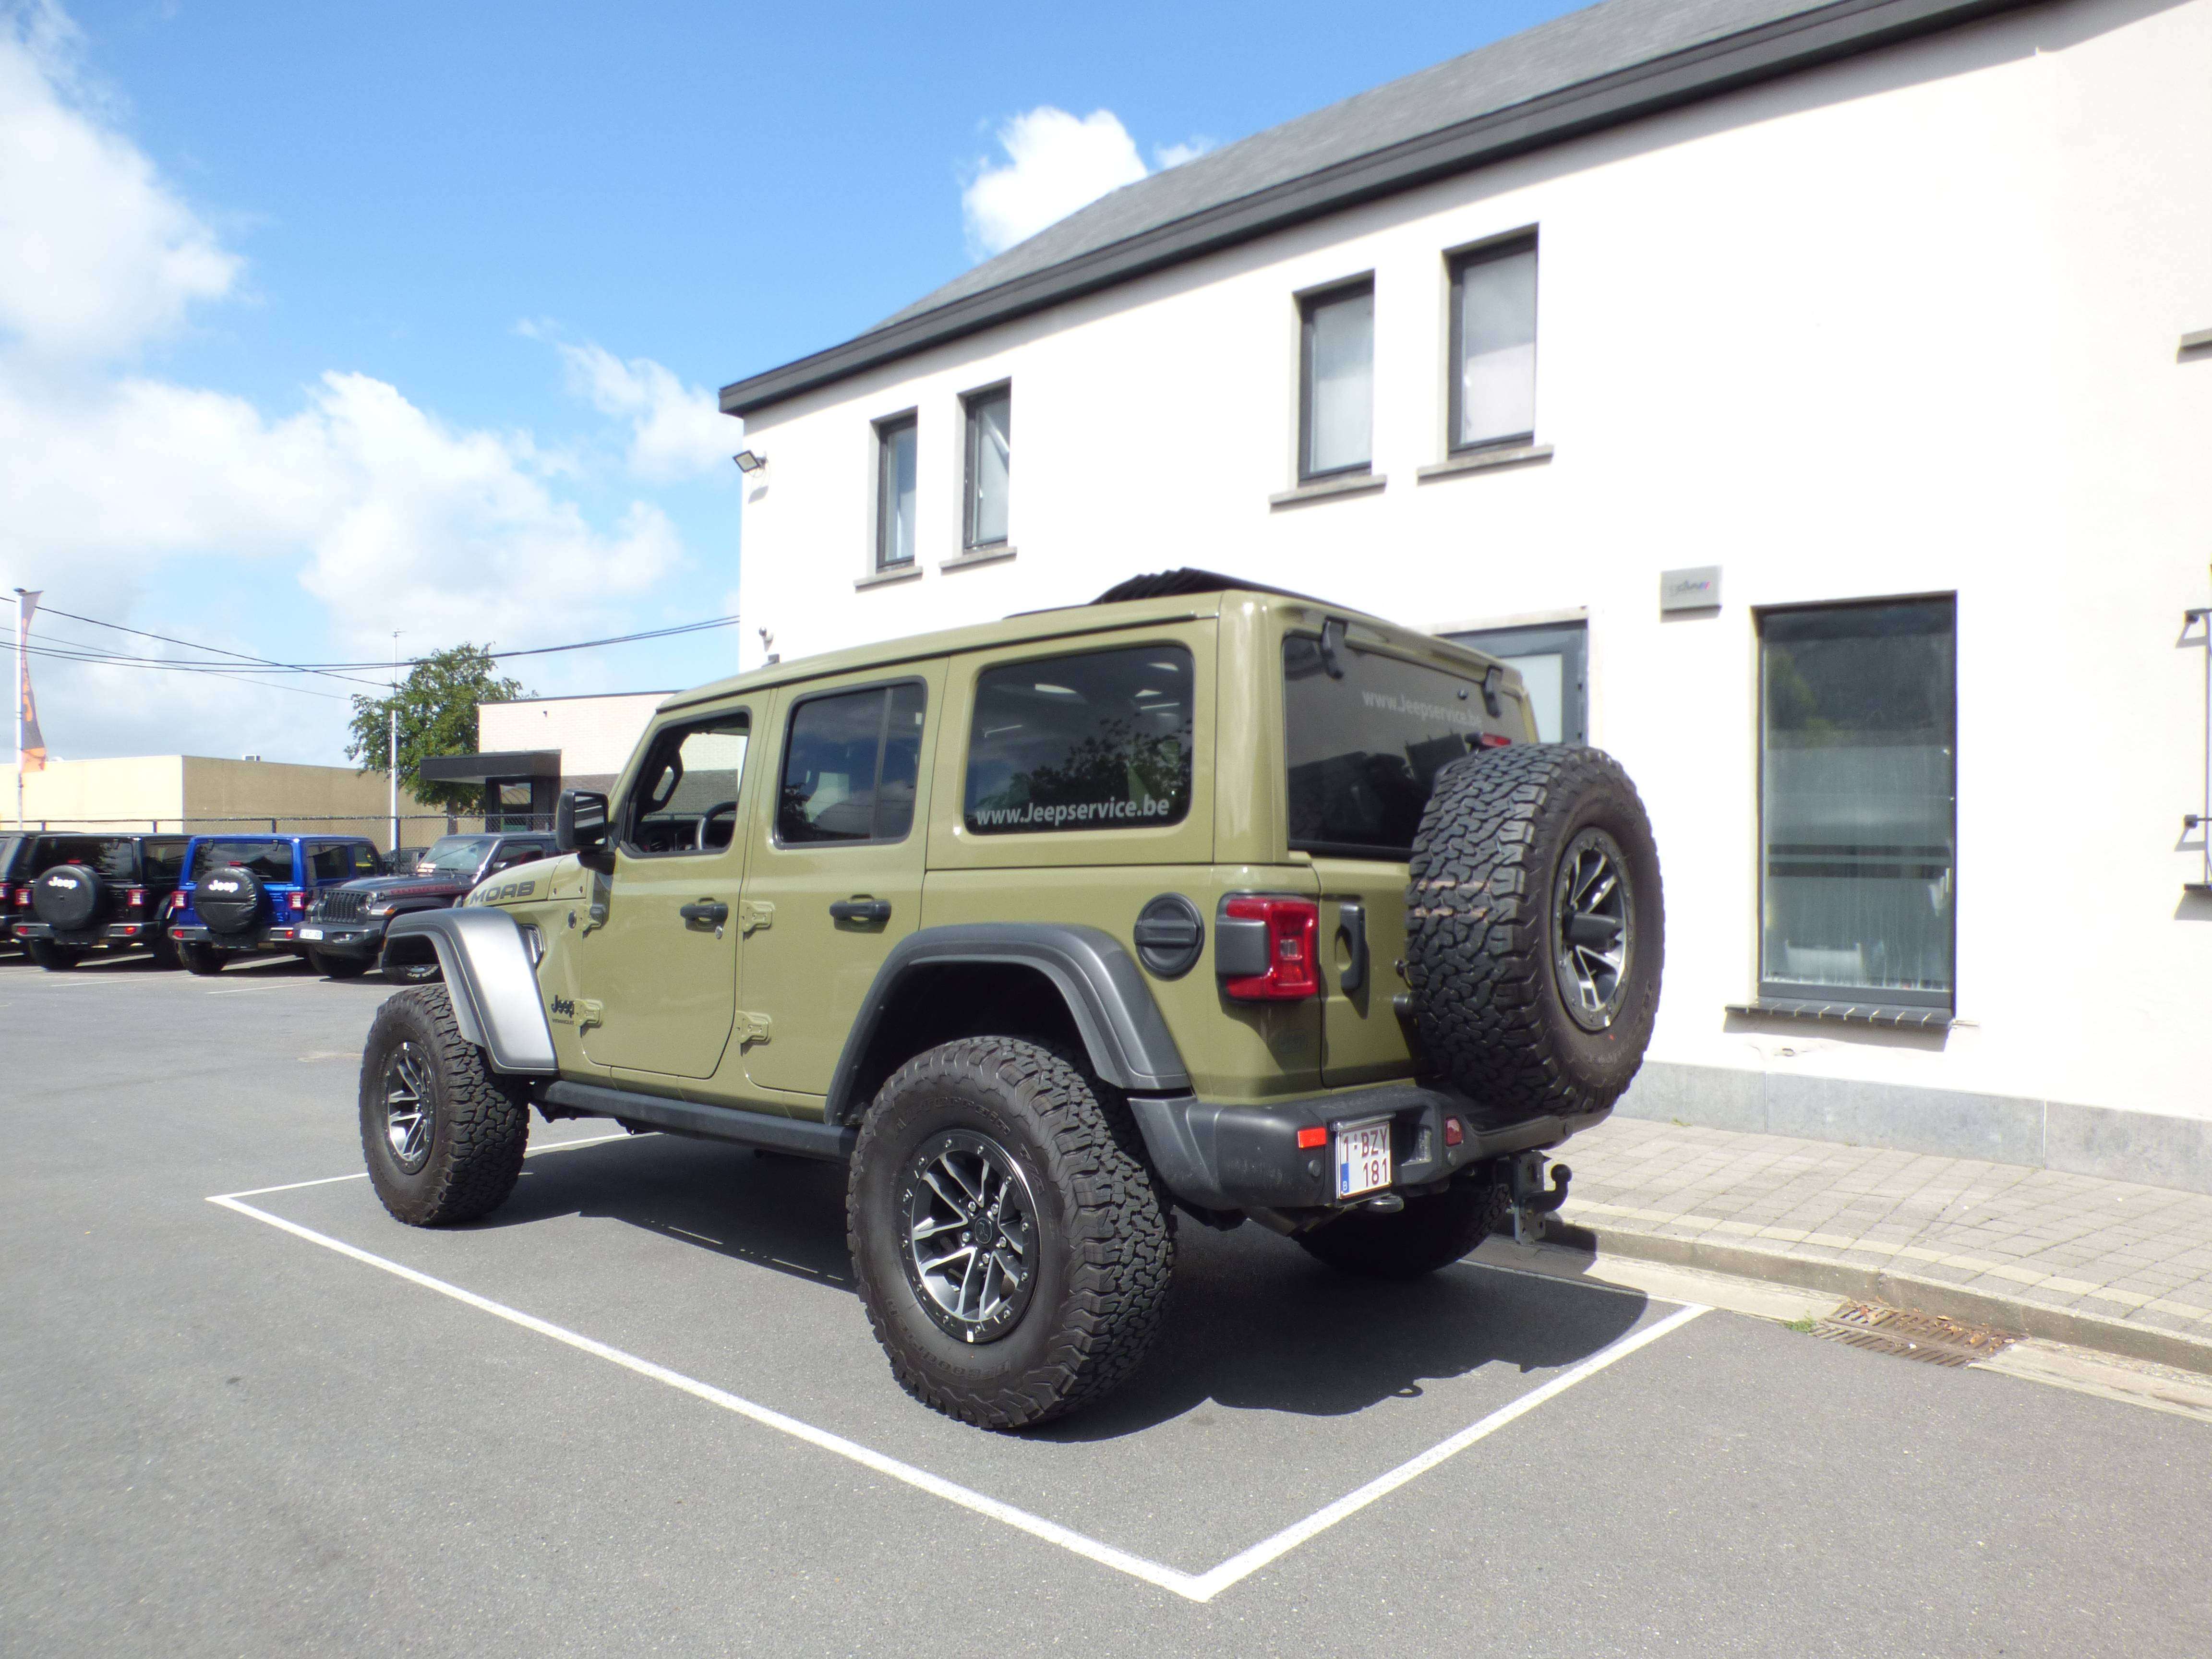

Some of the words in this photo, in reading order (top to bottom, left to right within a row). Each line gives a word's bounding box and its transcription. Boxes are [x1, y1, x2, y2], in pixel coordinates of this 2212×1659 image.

[975, 793, 1170, 826] www.Jeepservice.be
[48, 876, 77, 890] Jeep
[208, 879, 239, 893] Jeep
[469, 880, 536, 905] MOAB
[551, 995, 575, 1018] Jeep
[1363, 1157, 1387, 1187] 181
[1342, 1181, 1347, 1190] B
